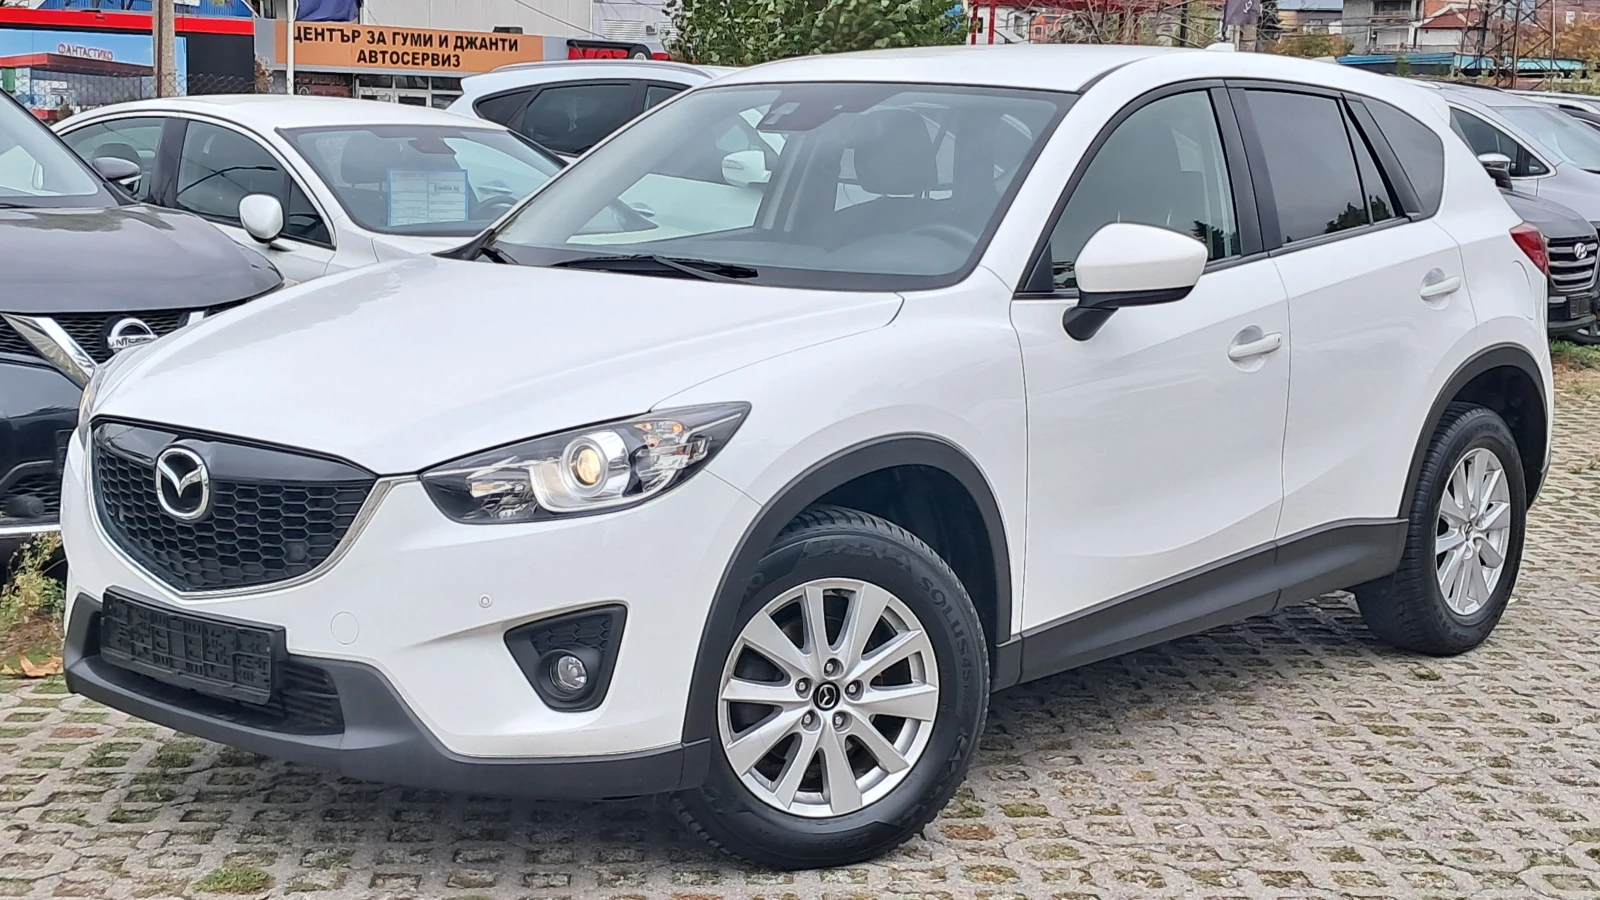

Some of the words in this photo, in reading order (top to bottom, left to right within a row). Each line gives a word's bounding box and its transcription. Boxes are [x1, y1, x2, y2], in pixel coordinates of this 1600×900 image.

[294, 26, 361, 43] ЦЕНТЪР
[366, 30, 387, 45] ЗА
[392, 32, 433, 48] ГУМИ
[438, 34, 449, 48] И
[453, 36, 518, 52] ДЖАНТИ
[58, 43, 114, 61] ФАНТАСТИКО
[356, 50, 461, 68] АВТОСЕРВИЗ
